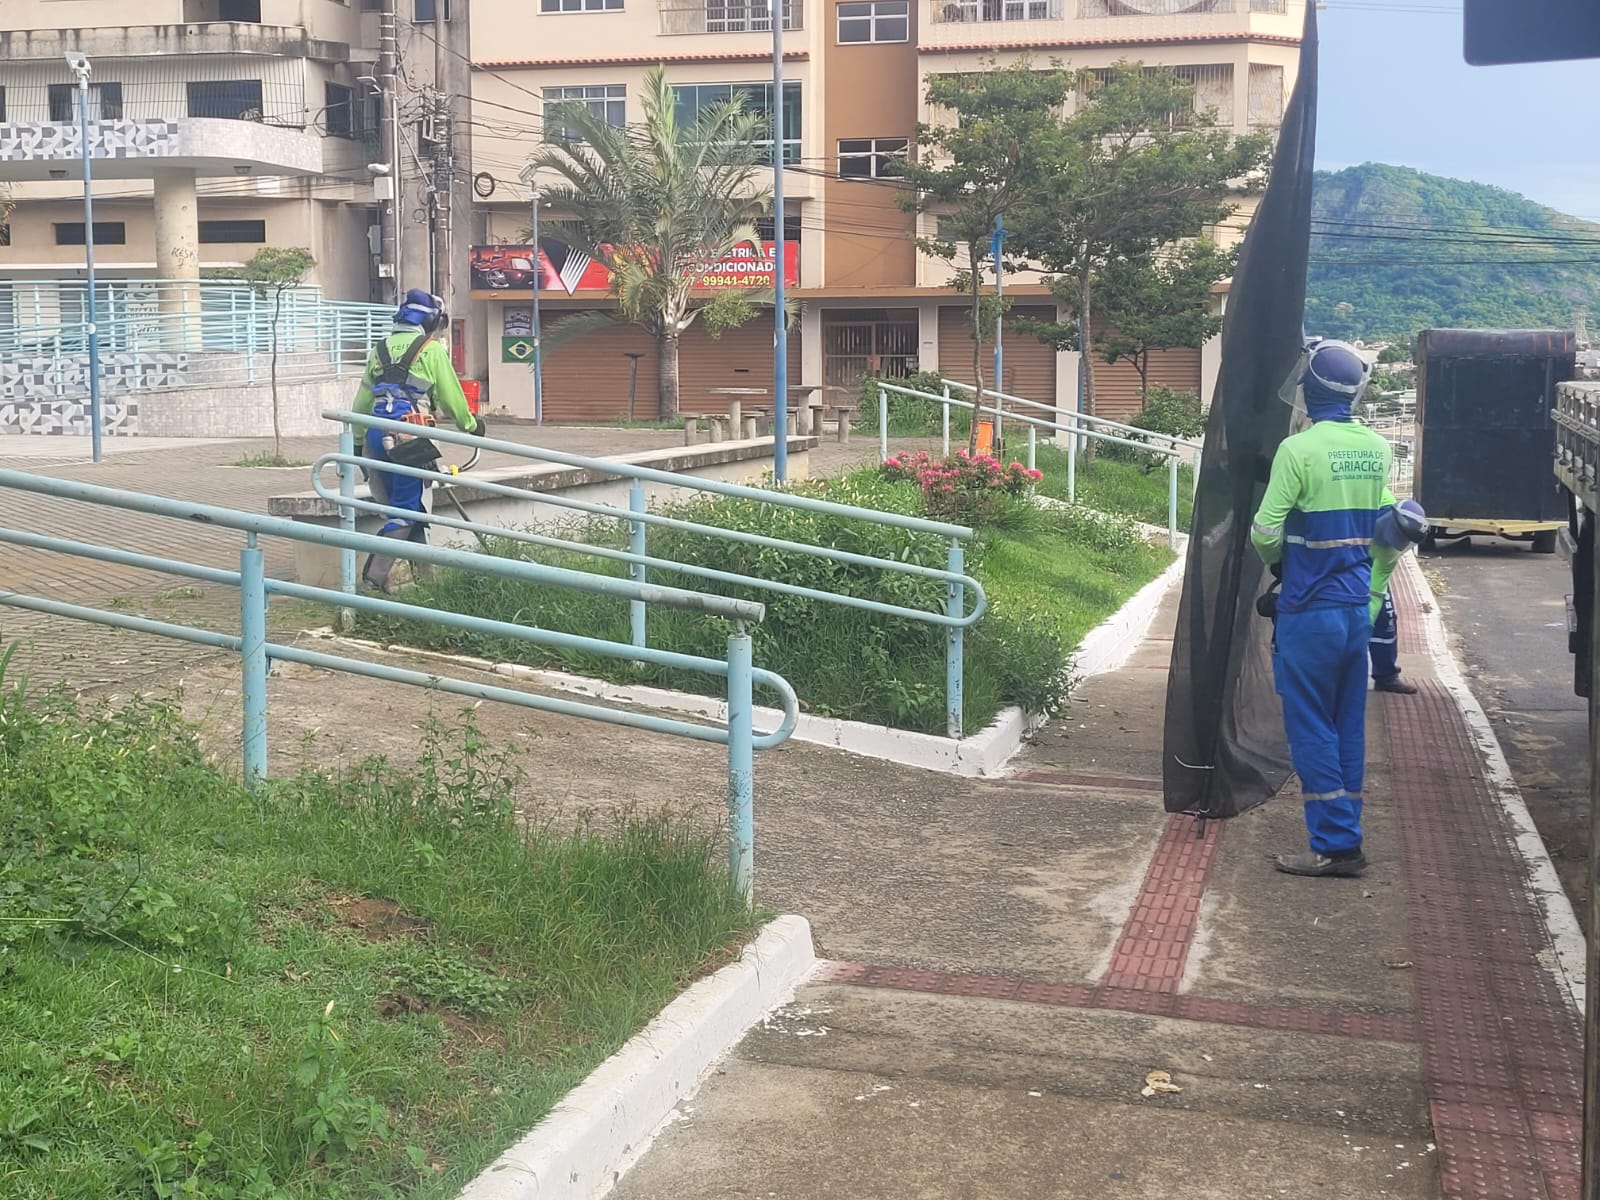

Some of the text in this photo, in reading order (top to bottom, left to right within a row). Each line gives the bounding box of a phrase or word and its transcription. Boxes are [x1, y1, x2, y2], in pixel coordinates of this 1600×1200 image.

[687, 261, 777, 273] CONDICIONAD
[1328, 450, 1385, 460] PREFEITURA DE
[1331, 461, 1384, 473] CARIACICA
